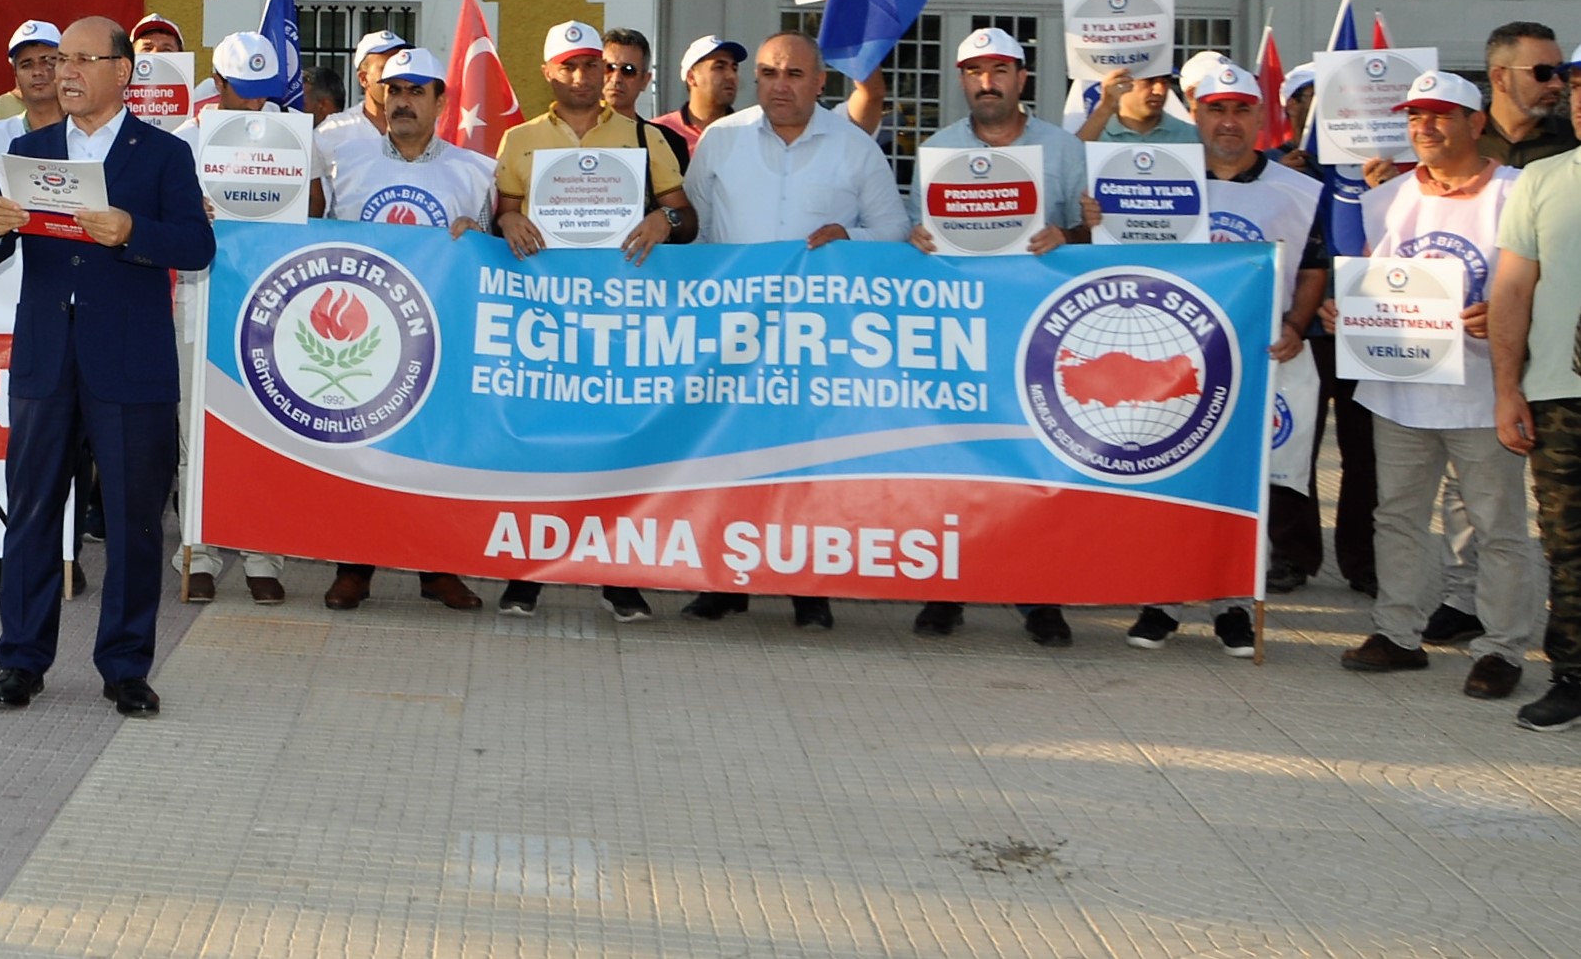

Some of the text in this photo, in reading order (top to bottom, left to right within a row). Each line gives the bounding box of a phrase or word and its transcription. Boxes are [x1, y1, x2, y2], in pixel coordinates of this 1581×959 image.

[1093, 23, 1116, 32] YILA
[1119, 21, 1156, 31] UZMAN
[1090, 51, 1150, 65] VERİLSİN
[123, 87, 174, 100] ğretmene
[148, 102, 179, 115] değer
[250, 153, 274, 162] YILA
[944, 188, 1019, 199] PROMOSYON
[1100, 182, 1194, 197] ÖĞRETİM YILINA
[224, 190, 280, 202] VERİLSİN
[946, 201, 1018, 212] MİKTARLARI
[1120, 199, 1175, 210] HAZIRLIK
[539, 207, 632, 217] kadrolu öğretmenliğe
[559, 218, 610, 229] yön vermeli
[943, 220, 1023, 231] GÜNCELLENSİN
[1126, 218, 1171, 229] ÖDENEĞİ
[1121, 232, 1177, 241] ARTIRILSIN
[479, 266, 984, 310] MEMUR-SEN KONFEDERASYONU
[1043, 281, 1139, 338] MEMUR
[1162, 291, 1215, 337] SEN
[1375, 303, 1420, 313] 12 YILA
[1343, 316, 1454, 331] BAŞÖĞRETMENLİK
[1366, 344, 1431, 359] VERİLSİN
[251, 348, 423, 433] EĞİTİMCİLER BİRLİĞİ SENDİKASI
[471, 359, 988, 412] EĞİTİMCİLER BİRLİĞİ SENDİKASI
[322, 395, 345, 405] 1992
[1029, 384, 1058, 429] MEMUR
[1138, 386, 1227, 472] KONFEDERASYONU
[484, 511, 960, 585] ADANA ŞUBESİ
